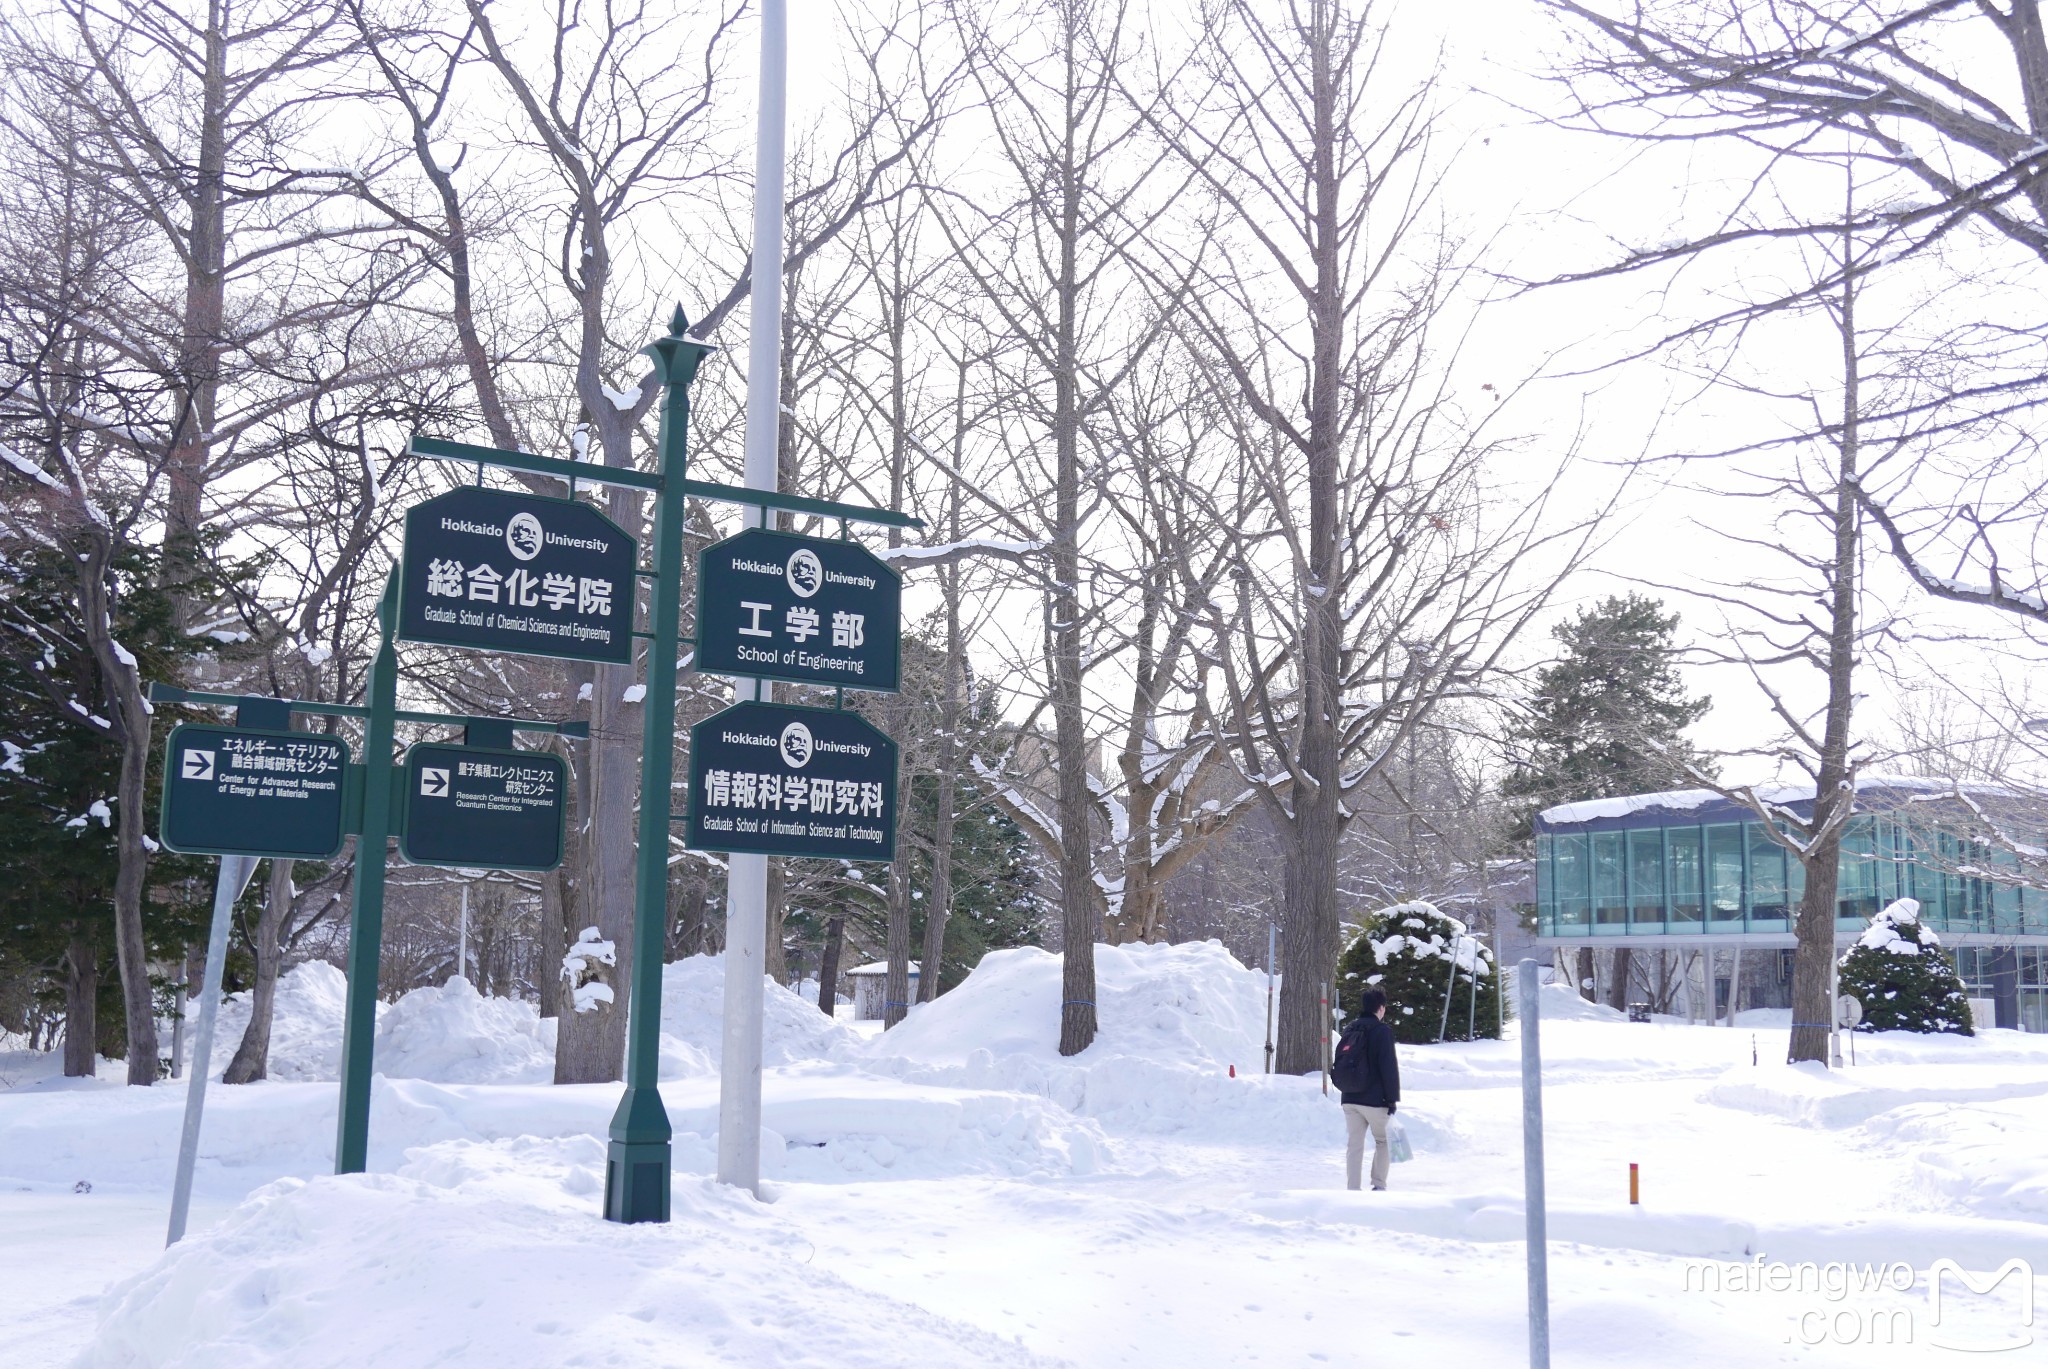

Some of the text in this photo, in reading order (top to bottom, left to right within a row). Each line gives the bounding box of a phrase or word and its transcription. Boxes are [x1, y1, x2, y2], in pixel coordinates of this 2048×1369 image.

[441, 517, 608, 553] Hokkaido University
[426, 557, 613, 615] 総合化学院
[731, 558, 876, 589] Hokkaido University
[424, 605, 610, 644] Graduate School of Chemical Sciences and Engineering
[738, 600, 865, 648] 工学部
[737, 645, 864, 674] School of Engineering
[221, 738, 339, 759] エネルギー・マテリアル
[722, 731, 871, 757] Hokkaido University
[231, 753, 338, 774] 融合領域研究センター
[457, 761, 554, 782] 量子集積エレクトロニクス
[218, 784, 308, 798] of Energy and Materials
[219, 773, 335, 789] Center for Advanced Research
[505, 780, 553, 795] 研究センター
[704, 768, 884, 817] 情報科学研究科
[455, 799, 522, 811] Quantum Electronics
[456, 791, 552, 806] Research Center for Integrated
[703, 815, 883, 843] Graduate School of Information Science and Technology
